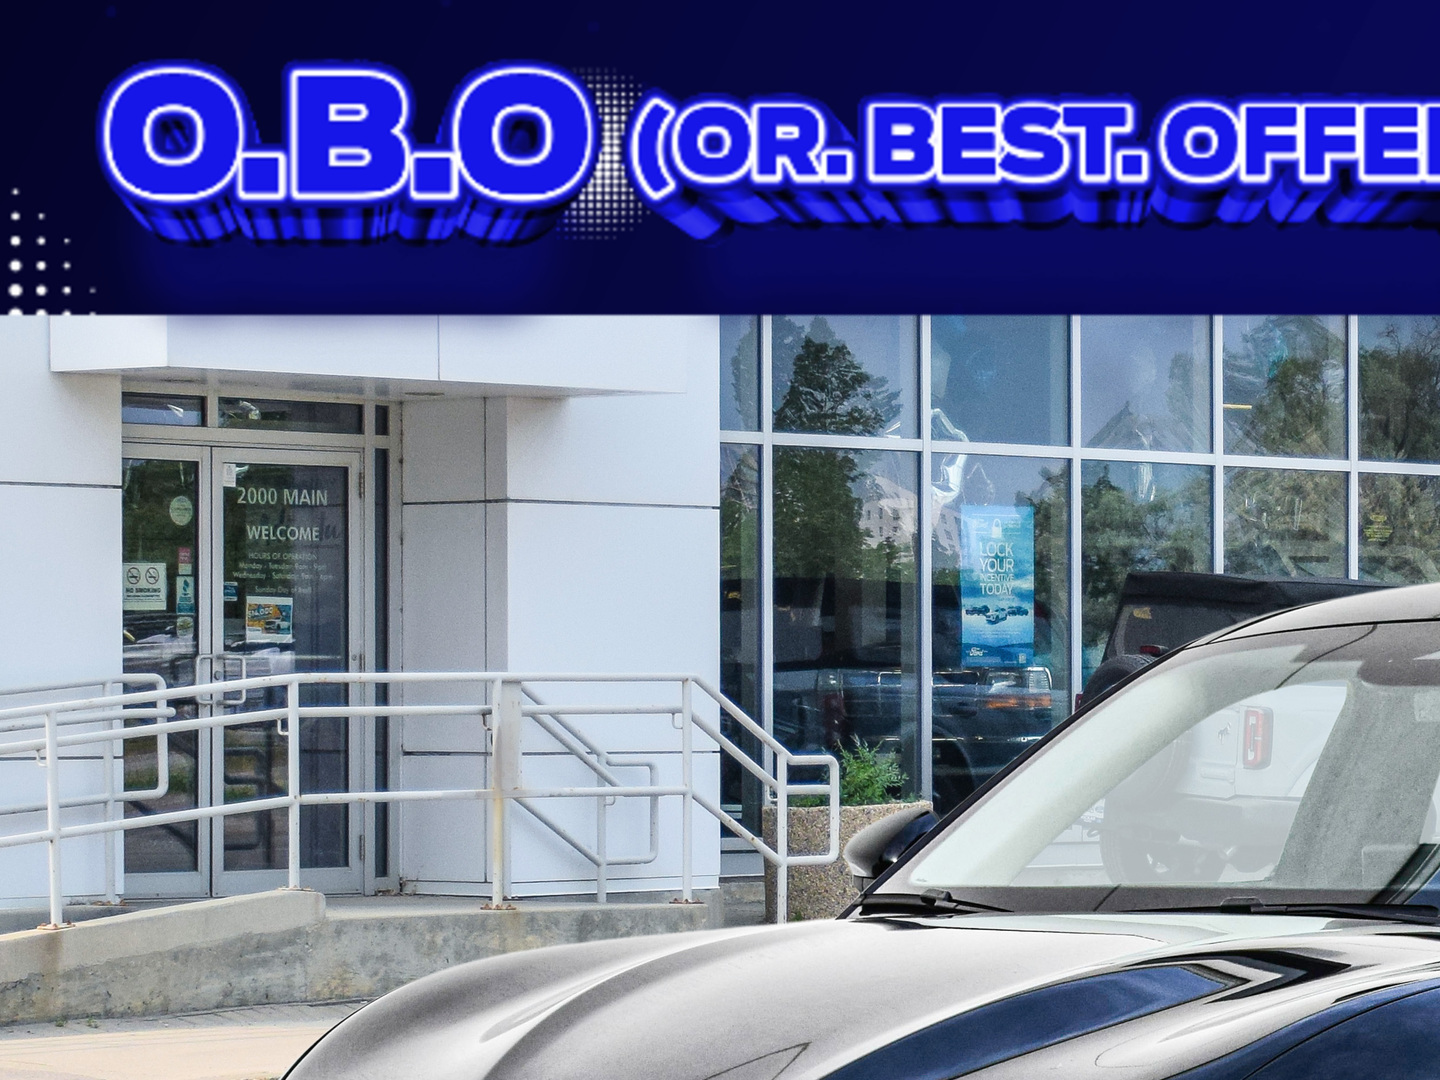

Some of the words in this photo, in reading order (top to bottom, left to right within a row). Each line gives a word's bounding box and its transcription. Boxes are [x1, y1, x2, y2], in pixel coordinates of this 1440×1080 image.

[236, 487, 278, 505] 2000
[283, 488, 329, 507] MAIN
[245, 524, 320, 542] WELCOME
[979, 541, 1014, 557] LOCK
[979, 558, 1015, 572] YOUR
[979, 583, 1014, 595] TODAY
